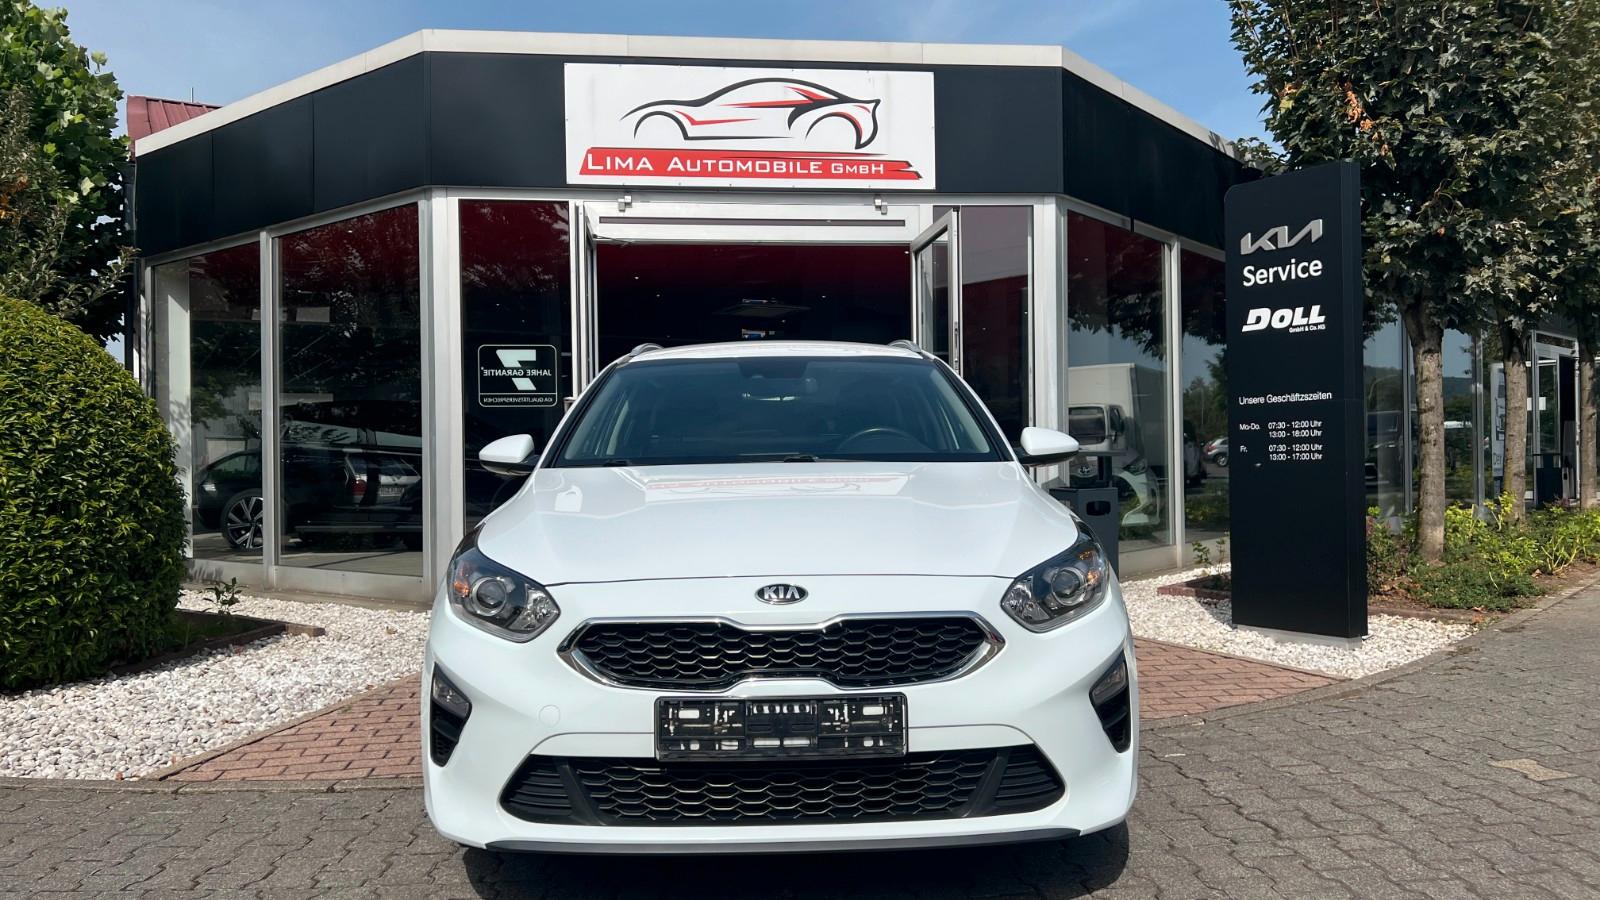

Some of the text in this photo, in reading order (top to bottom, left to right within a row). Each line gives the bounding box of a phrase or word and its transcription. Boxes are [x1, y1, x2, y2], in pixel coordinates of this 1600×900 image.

[586, 153, 653, 172] LIMA
[667, 156, 823, 175] AUTOMOBILE
[1240, 218, 1323, 255] KIA
[1242, 258, 1323, 287] Service
[1238, 396, 1265, 405] Unsere
[1268, 421, 1286, 429] 07:30
[1291, 420, 1309, 428] 12:00
[1310, 420, 1323, 428] Uhr
[1268, 430, 1286, 438] 13:00
[1291, 429, 1309, 437] 18:00
[1310, 429, 1323, 437] Uhr
[1268, 444, 1286, 452] 07:30
[1292, 443, 1310, 451] 12:00
[1311, 443, 1323, 451] Uhr
[1269, 453, 1286, 461] 13:00
[1292, 452, 1310, 460] 17:00
[1311, 452, 1323, 460] Uhr
[763, 586, 800, 600] KIA
